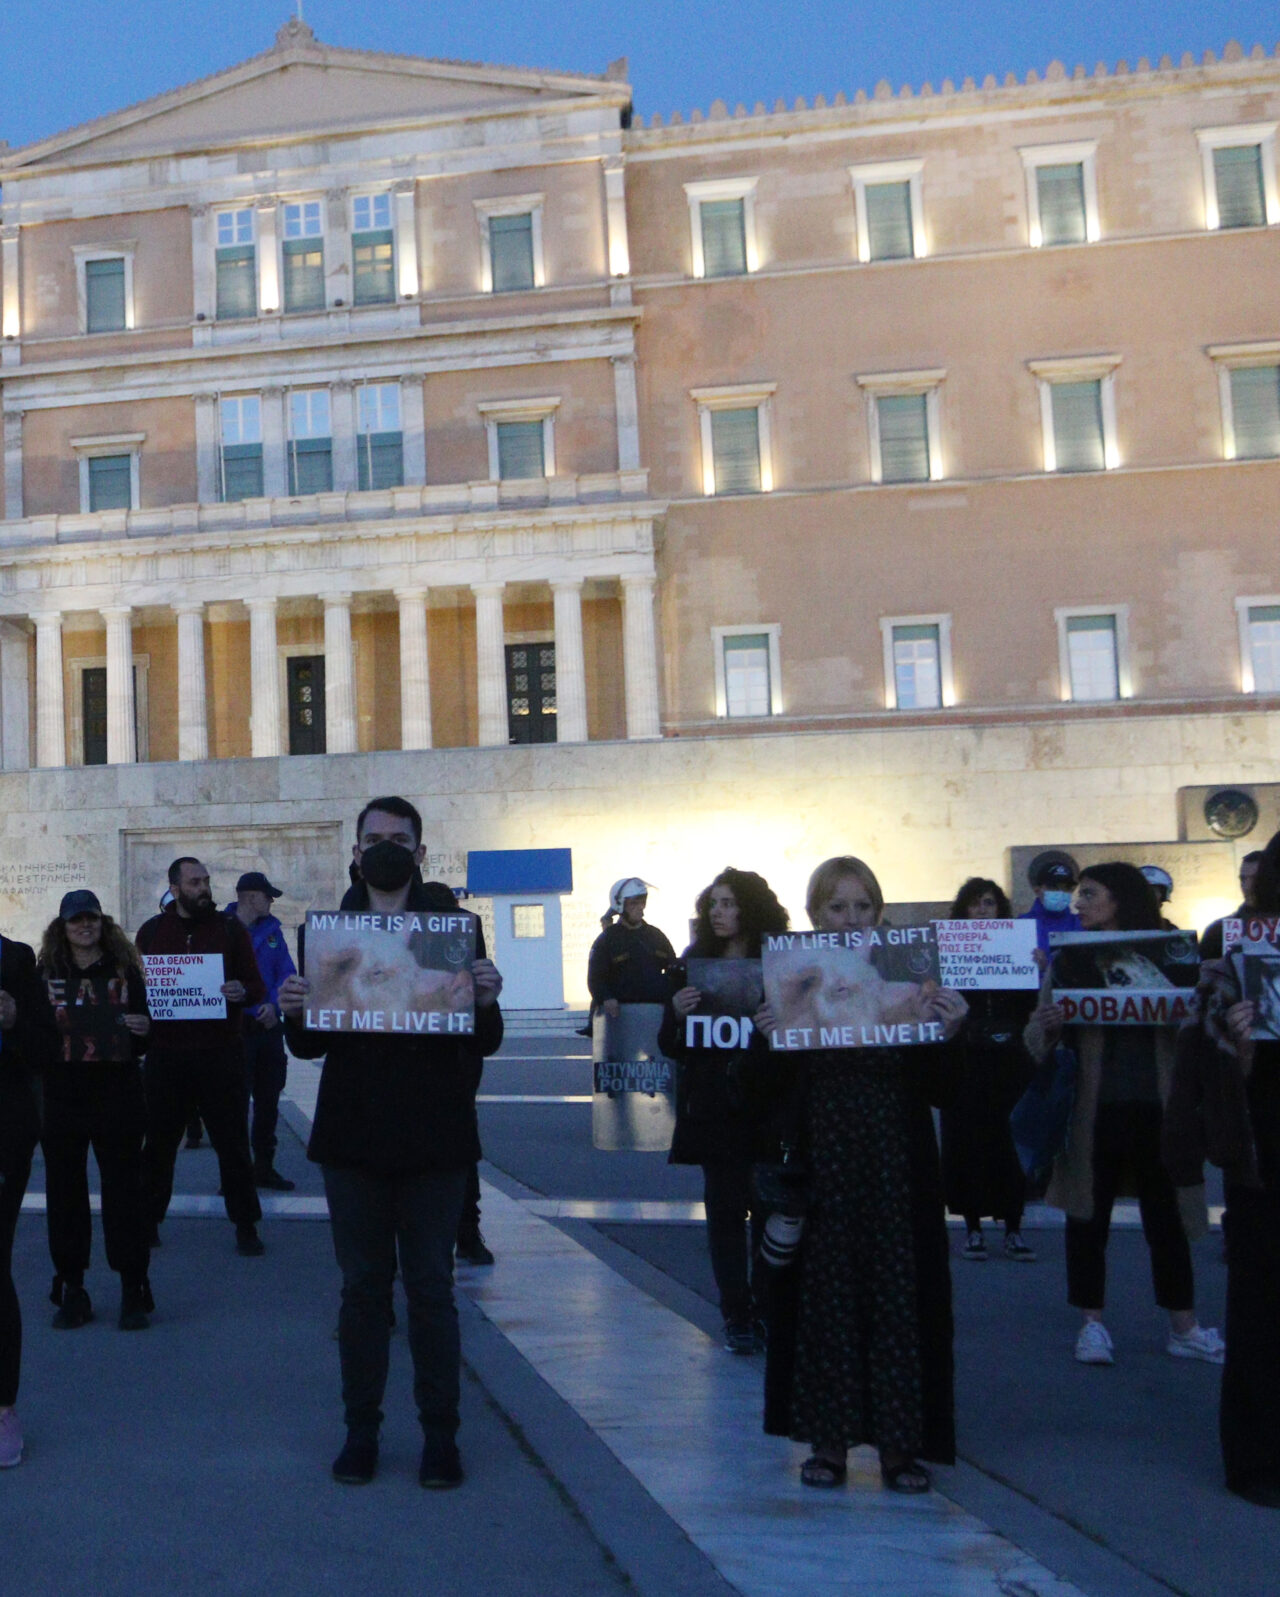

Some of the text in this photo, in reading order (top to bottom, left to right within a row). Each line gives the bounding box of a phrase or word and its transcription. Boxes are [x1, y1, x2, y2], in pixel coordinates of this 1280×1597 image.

[311, 915, 473, 933] MY LIFE IS A GIFT.
[948, 921, 968, 930] ΖΩΑ
[971, 921, 1014, 930] ΘΕΛΟΥΝ
[768, 927, 934, 951] MY LIFE IS A GIFT.
[939, 932, 992, 941] ΛΕΥΘΕΡΙΑ.
[939, 943, 961, 952] ΠΩΣ
[147, 956, 204, 965] ΖΩΑ ΘΕΛΟΥΝ
[940, 955, 948, 964] Ν
[145, 967, 185, 976] ΕΥΘΕΡΙΑ.
[940, 966, 1035, 975] ΤΑΣΟΥ ΔΙΠΛΑ ΜΟΥ
[147, 978, 158, 986] ΩΣ
[150, 987, 206, 997] ΣΥΜΦΩΝΕΙΣ,
[147, 997, 223, 1007] ΑΣΟΥ ΔΙΠΛΑ ΜΟΥ
[153, 1009, 175, 1017] ΛΙΓΟ.
[1060, 995, 1196, 1022] ΦΟΒΑΜΑ
[306, 1009, 473, 1032] LET ME LIVE IT.
[771, 1021, 945, 1049] LET ME LIVE IT.
[597, 1062, 670, 1078] ΑΣΤΥΝΟΜΙΑ
[599, 1078, 667, 1092] POLICE
